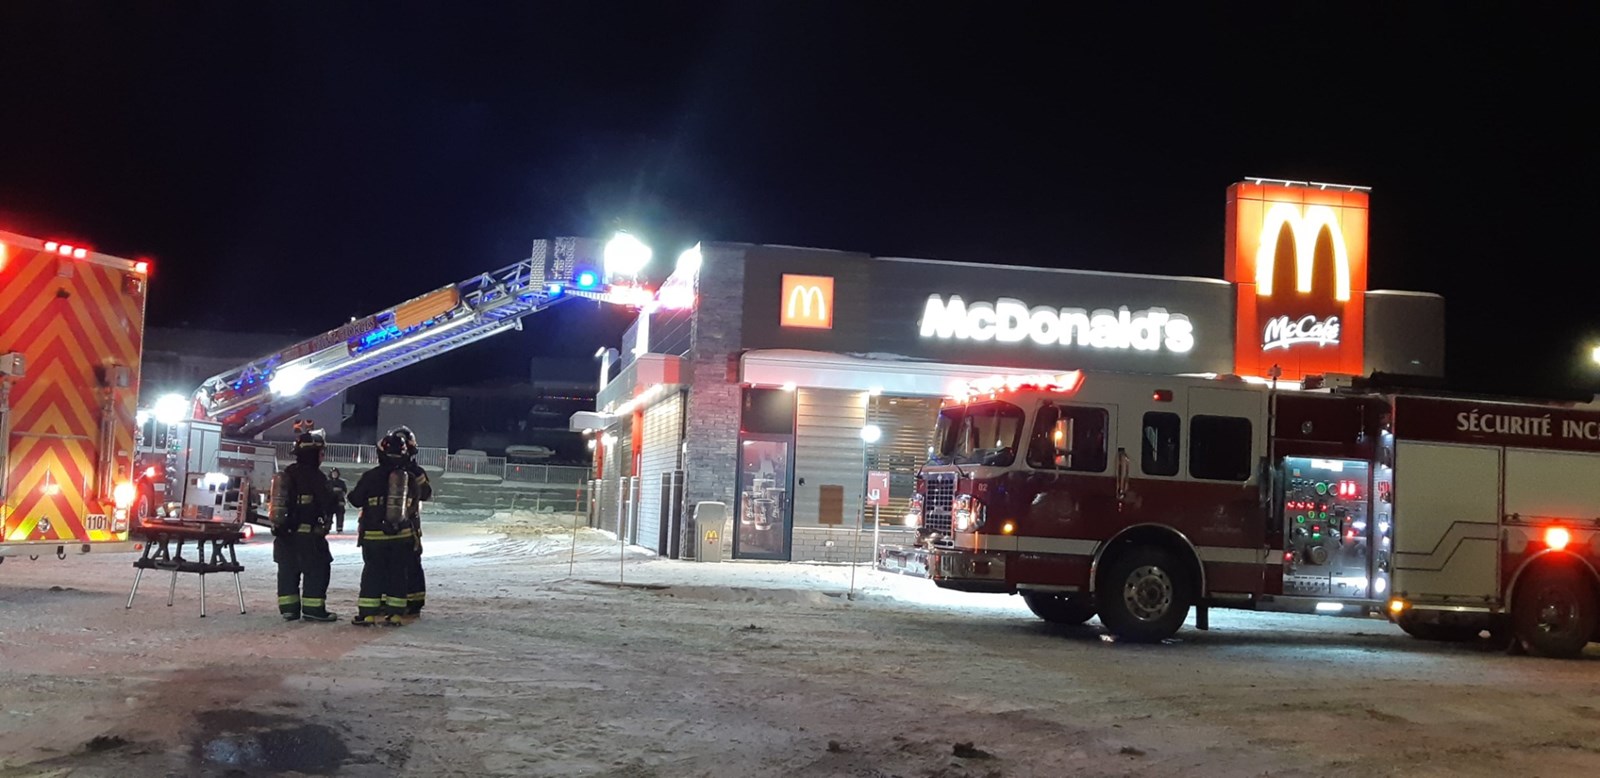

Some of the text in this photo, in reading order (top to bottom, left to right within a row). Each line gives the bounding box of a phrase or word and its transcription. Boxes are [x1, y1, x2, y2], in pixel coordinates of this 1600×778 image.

[919, 294, 1194, 352] McDonald's
[1263, 315, 1340, 348] McCafé
[1456, 409, 1600, 440] SÉCURITÉ INC
[882, 478, 888, 488] 1
[978, 483, 988, 492] 02
[87, 516, 107, 529] 1101
